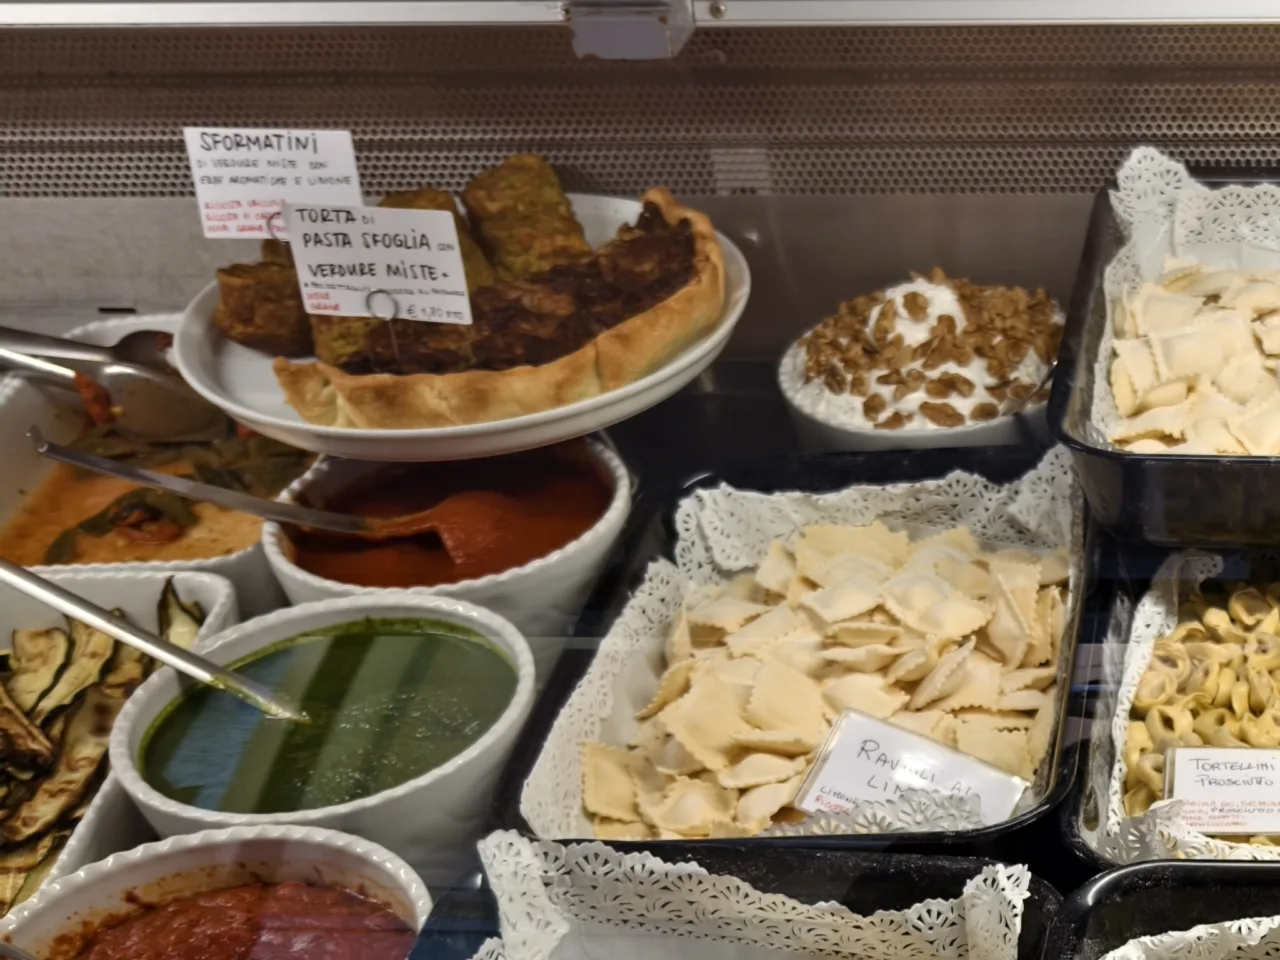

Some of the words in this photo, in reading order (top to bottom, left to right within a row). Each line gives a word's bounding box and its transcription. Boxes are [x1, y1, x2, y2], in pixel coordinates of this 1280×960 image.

[200, 132, 318, 153] SFORMATINI
[296, 208, 356, 223] TORTA
[303, 233, 352, 248] PASTA
[362, 229, 431, 250] SFOGLIA
[307, 263, 376, 277] VERDURE
[1188, 757, 1275, 772] TORTELLINI
[1194, 774, 1274, 788] PROSCIUTTO
